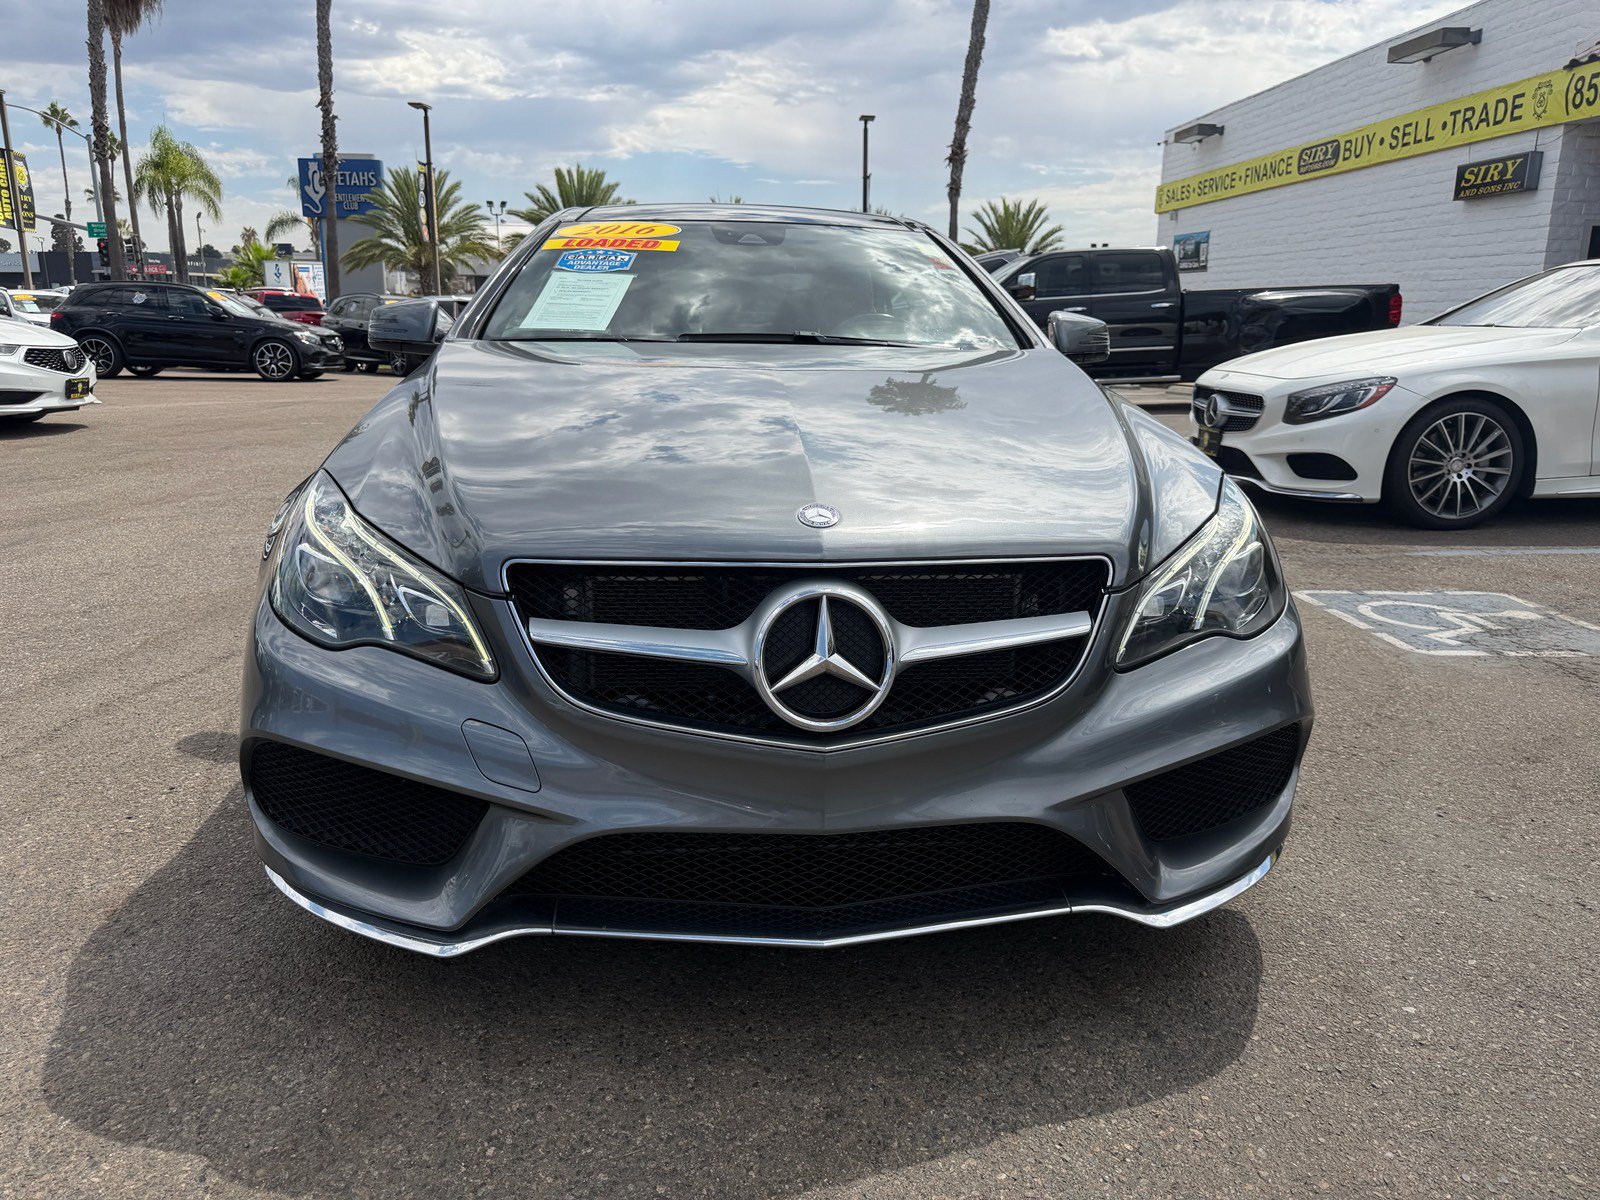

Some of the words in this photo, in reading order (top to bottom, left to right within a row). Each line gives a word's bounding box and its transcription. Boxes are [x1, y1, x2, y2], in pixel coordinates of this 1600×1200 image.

[1342, 132, 1376, 162] BUY
[1389, 118, 1435, 150] SELL
[1449, 92, 1525, 136] TRADE
[1300, 141, 1338, 165] SIRY
[1165, 183, 1191, 204] SALES
[1197, 171, 1237, 197] SERVICE
[1244, 156, 1293, 185] FINANCE
[1460, 158, 1524, 187] SIRY
[1458, 188, 1477, 198] AND
[1477, 184, 1502, 195] SONS
[1503, 181, 1520, 191] INC
[1, 189, 13, 220] AUTO
[343, 201, 359, 210] CLUB
[574, 224, 659, 236] 2016
[561, 238, 662, 250] LOADED
[565, 254, 630, 262] CARFAX
